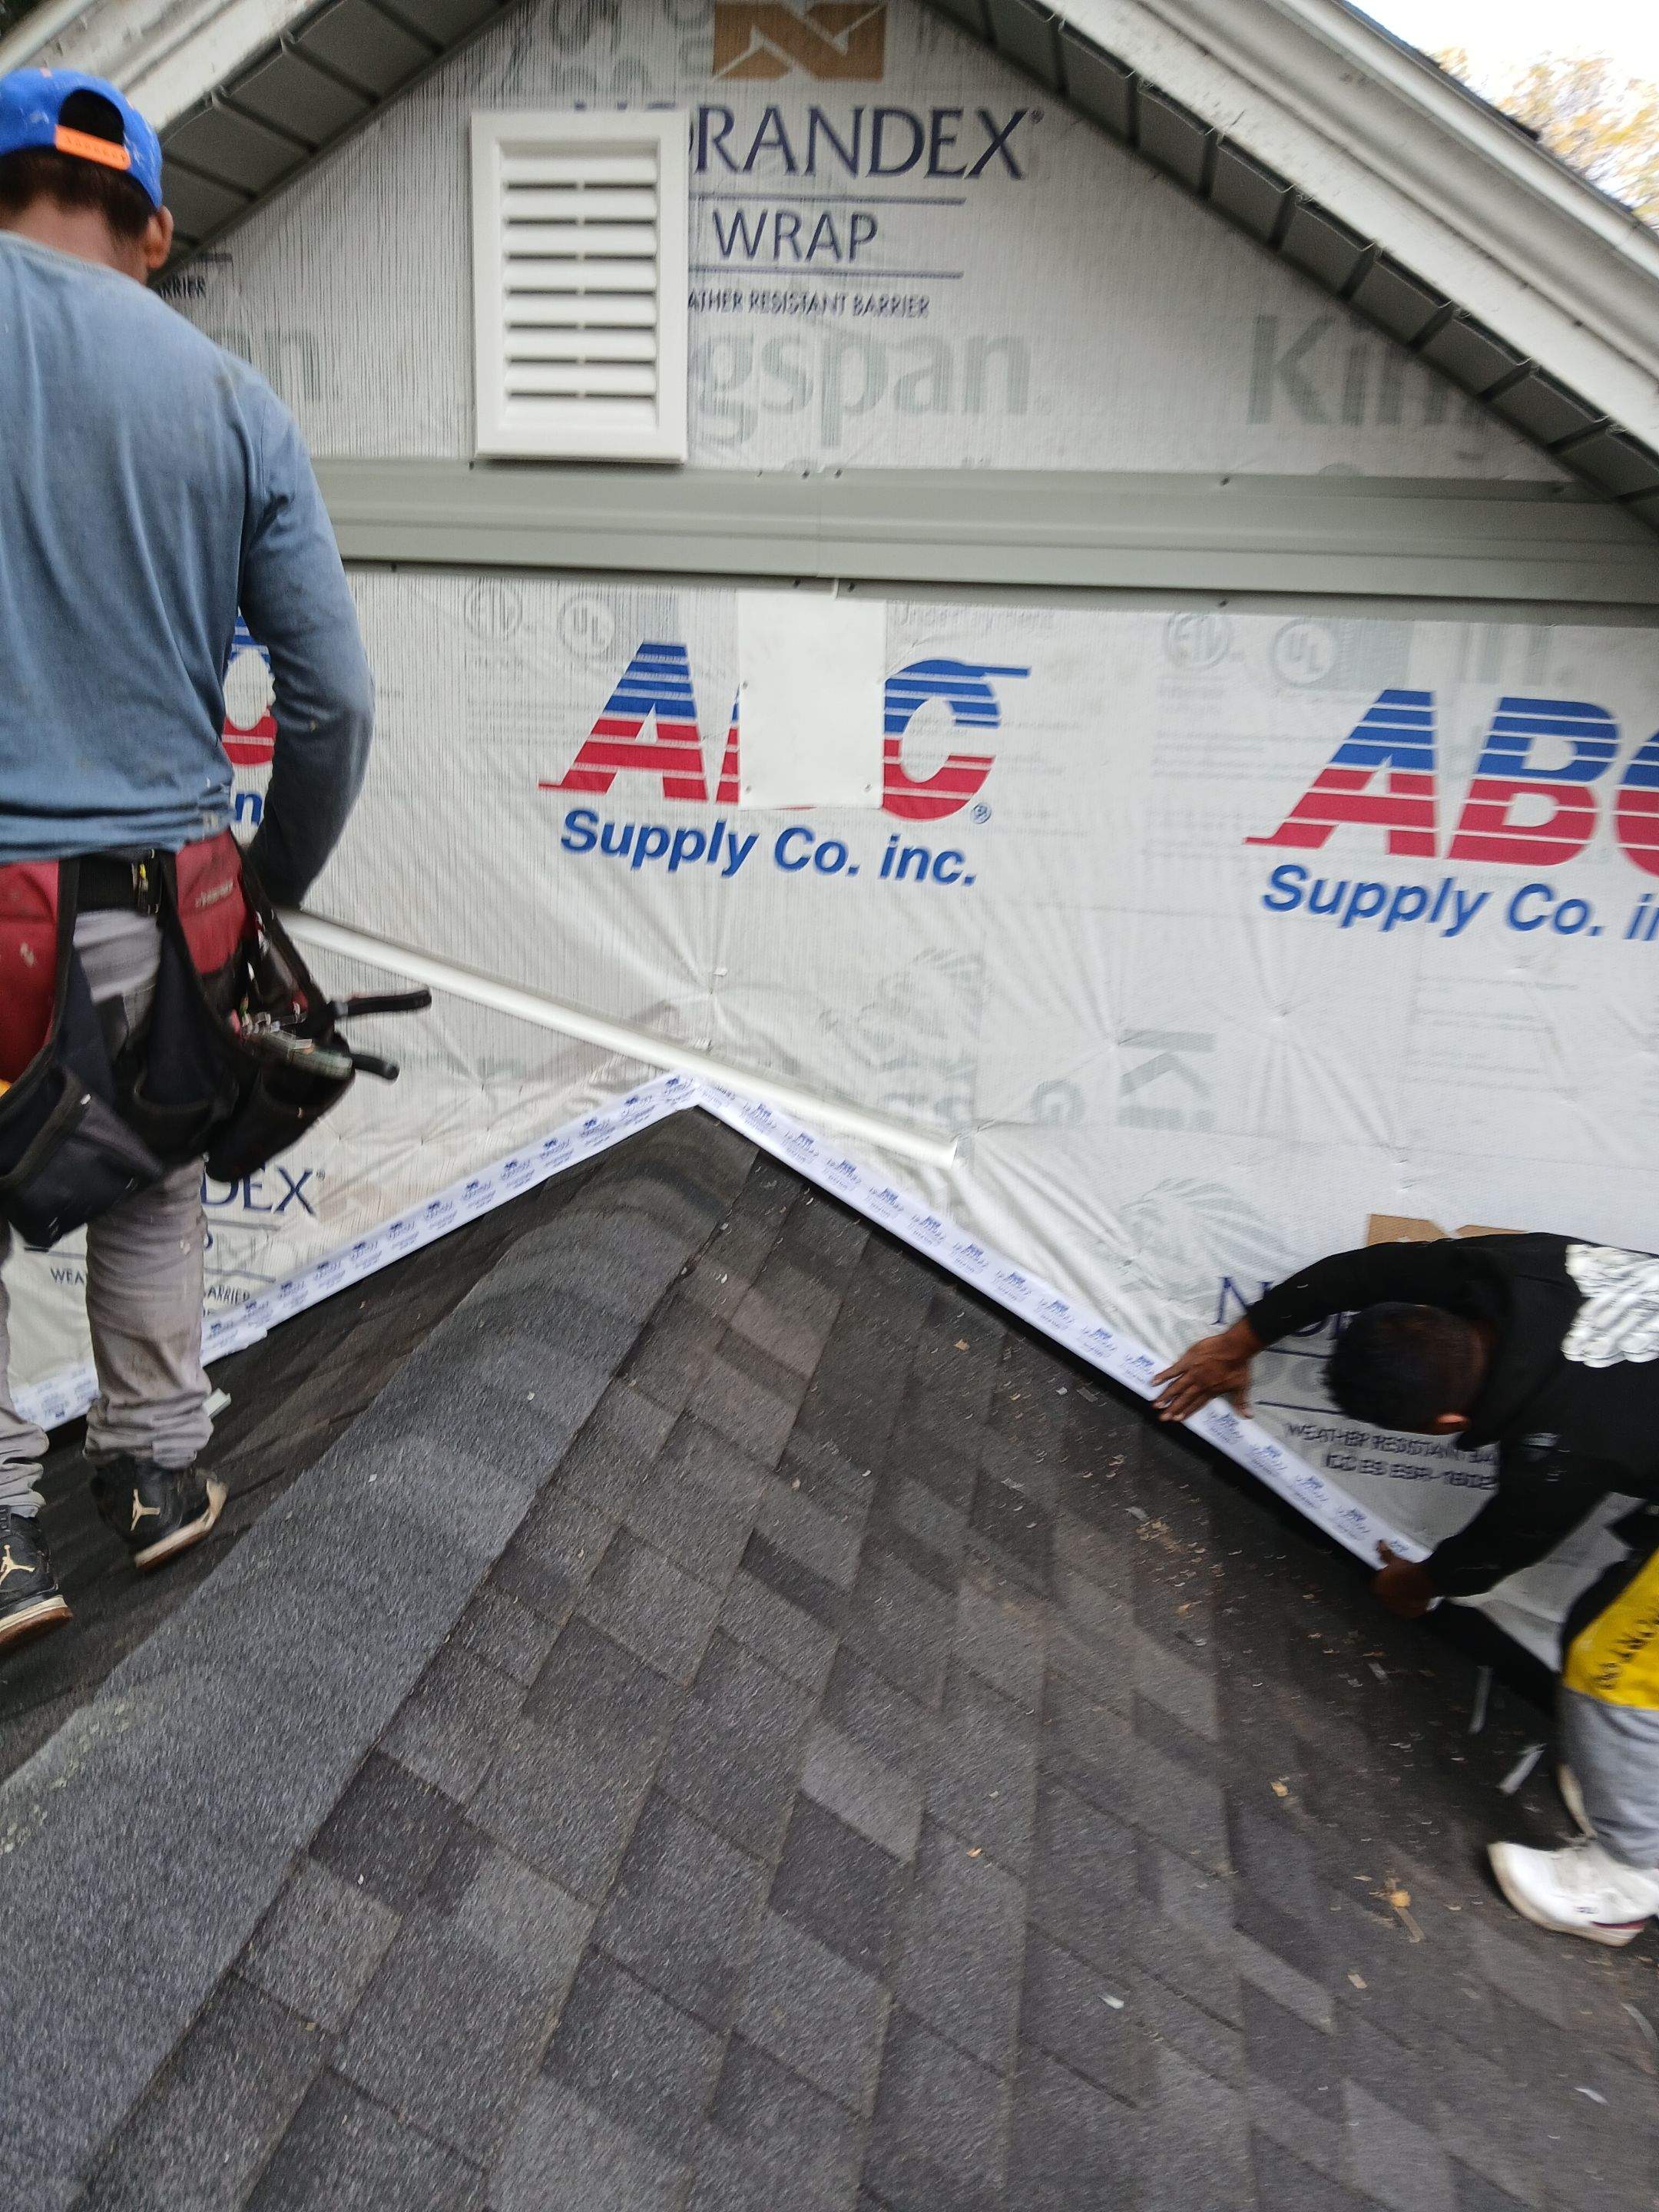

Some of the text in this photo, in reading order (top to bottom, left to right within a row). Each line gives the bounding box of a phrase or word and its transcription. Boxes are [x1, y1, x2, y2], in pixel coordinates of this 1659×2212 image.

[575, 103, 1028, 180] RANDEX
[712, 208, 879, 263] WRAP
[687, 286, 930, 320] ATHER RESISTANT BARRIER
[695, 333, 1031, 448] gspan
[538, 641, 1031, 822] AC
[560, 806, 977, 886] Supply Co. inc.
[1261, 863, 1493, 938] Supply
[1507, 882, 1604, 936] Co.
